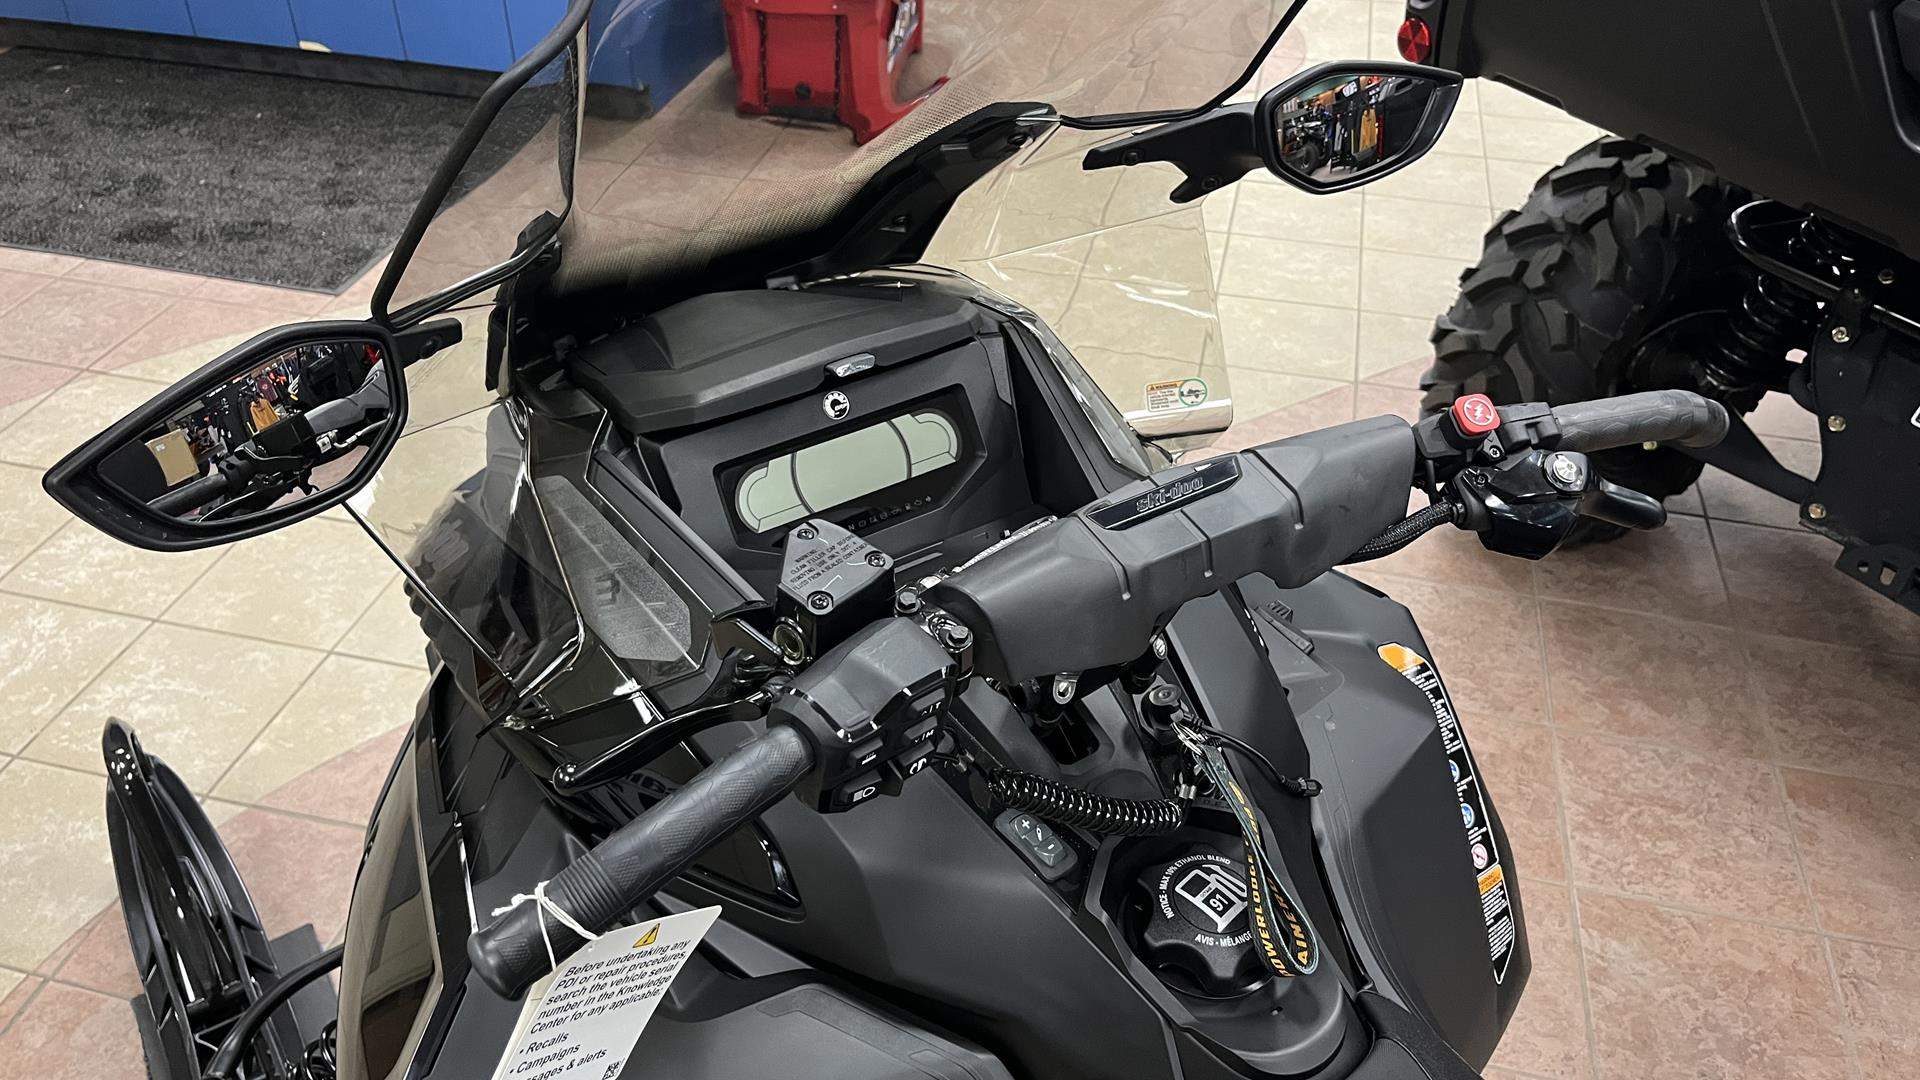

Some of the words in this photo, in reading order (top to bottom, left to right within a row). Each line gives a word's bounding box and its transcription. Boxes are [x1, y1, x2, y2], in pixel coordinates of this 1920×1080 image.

[1165, 865, 1178, 876] 10%
[1174, 854, 1206, 868] ETHANOL
[1206, 854, 1231, 865] BLEND
[1159, 875, 1171, 890] MAX
[1159, 893, 1175, 919] NOTICE
[1209, 893, 1229, 912] 91
[1194, 933, 1215, 946] AVIS
[564, 961, 605, 977] Before
[606, 944, 671, 967] undertaking
[670, 940, 692, 951] any
[546, 986, 588, 1005] search
[588, 982, 608, 994] the
[610, 970, 648, 987] vehicle
[648, 960, 680, 977] serial
[555, 976, 580, 991] PDI
[579, 975, 594, 985] or
[594, 964, 628, 981] repair
[537, 1000, 584, 1020] number
[583, 995, 596, 1007] in
[597, 990, 615, 1002] the
[616, 975, 672, 997] Knowledge
[530, 1015, 570, 1034] Center
[569, 1010, 588, 1022] for
[587, 1003, 609, 1016] any
[525, 1032, 570, 1055] Recalls
[516, 1044, 582, 1074] Campaigns
[566, 1059, 576, 1071] &
[577, 1048, 608, 1067] alerts
